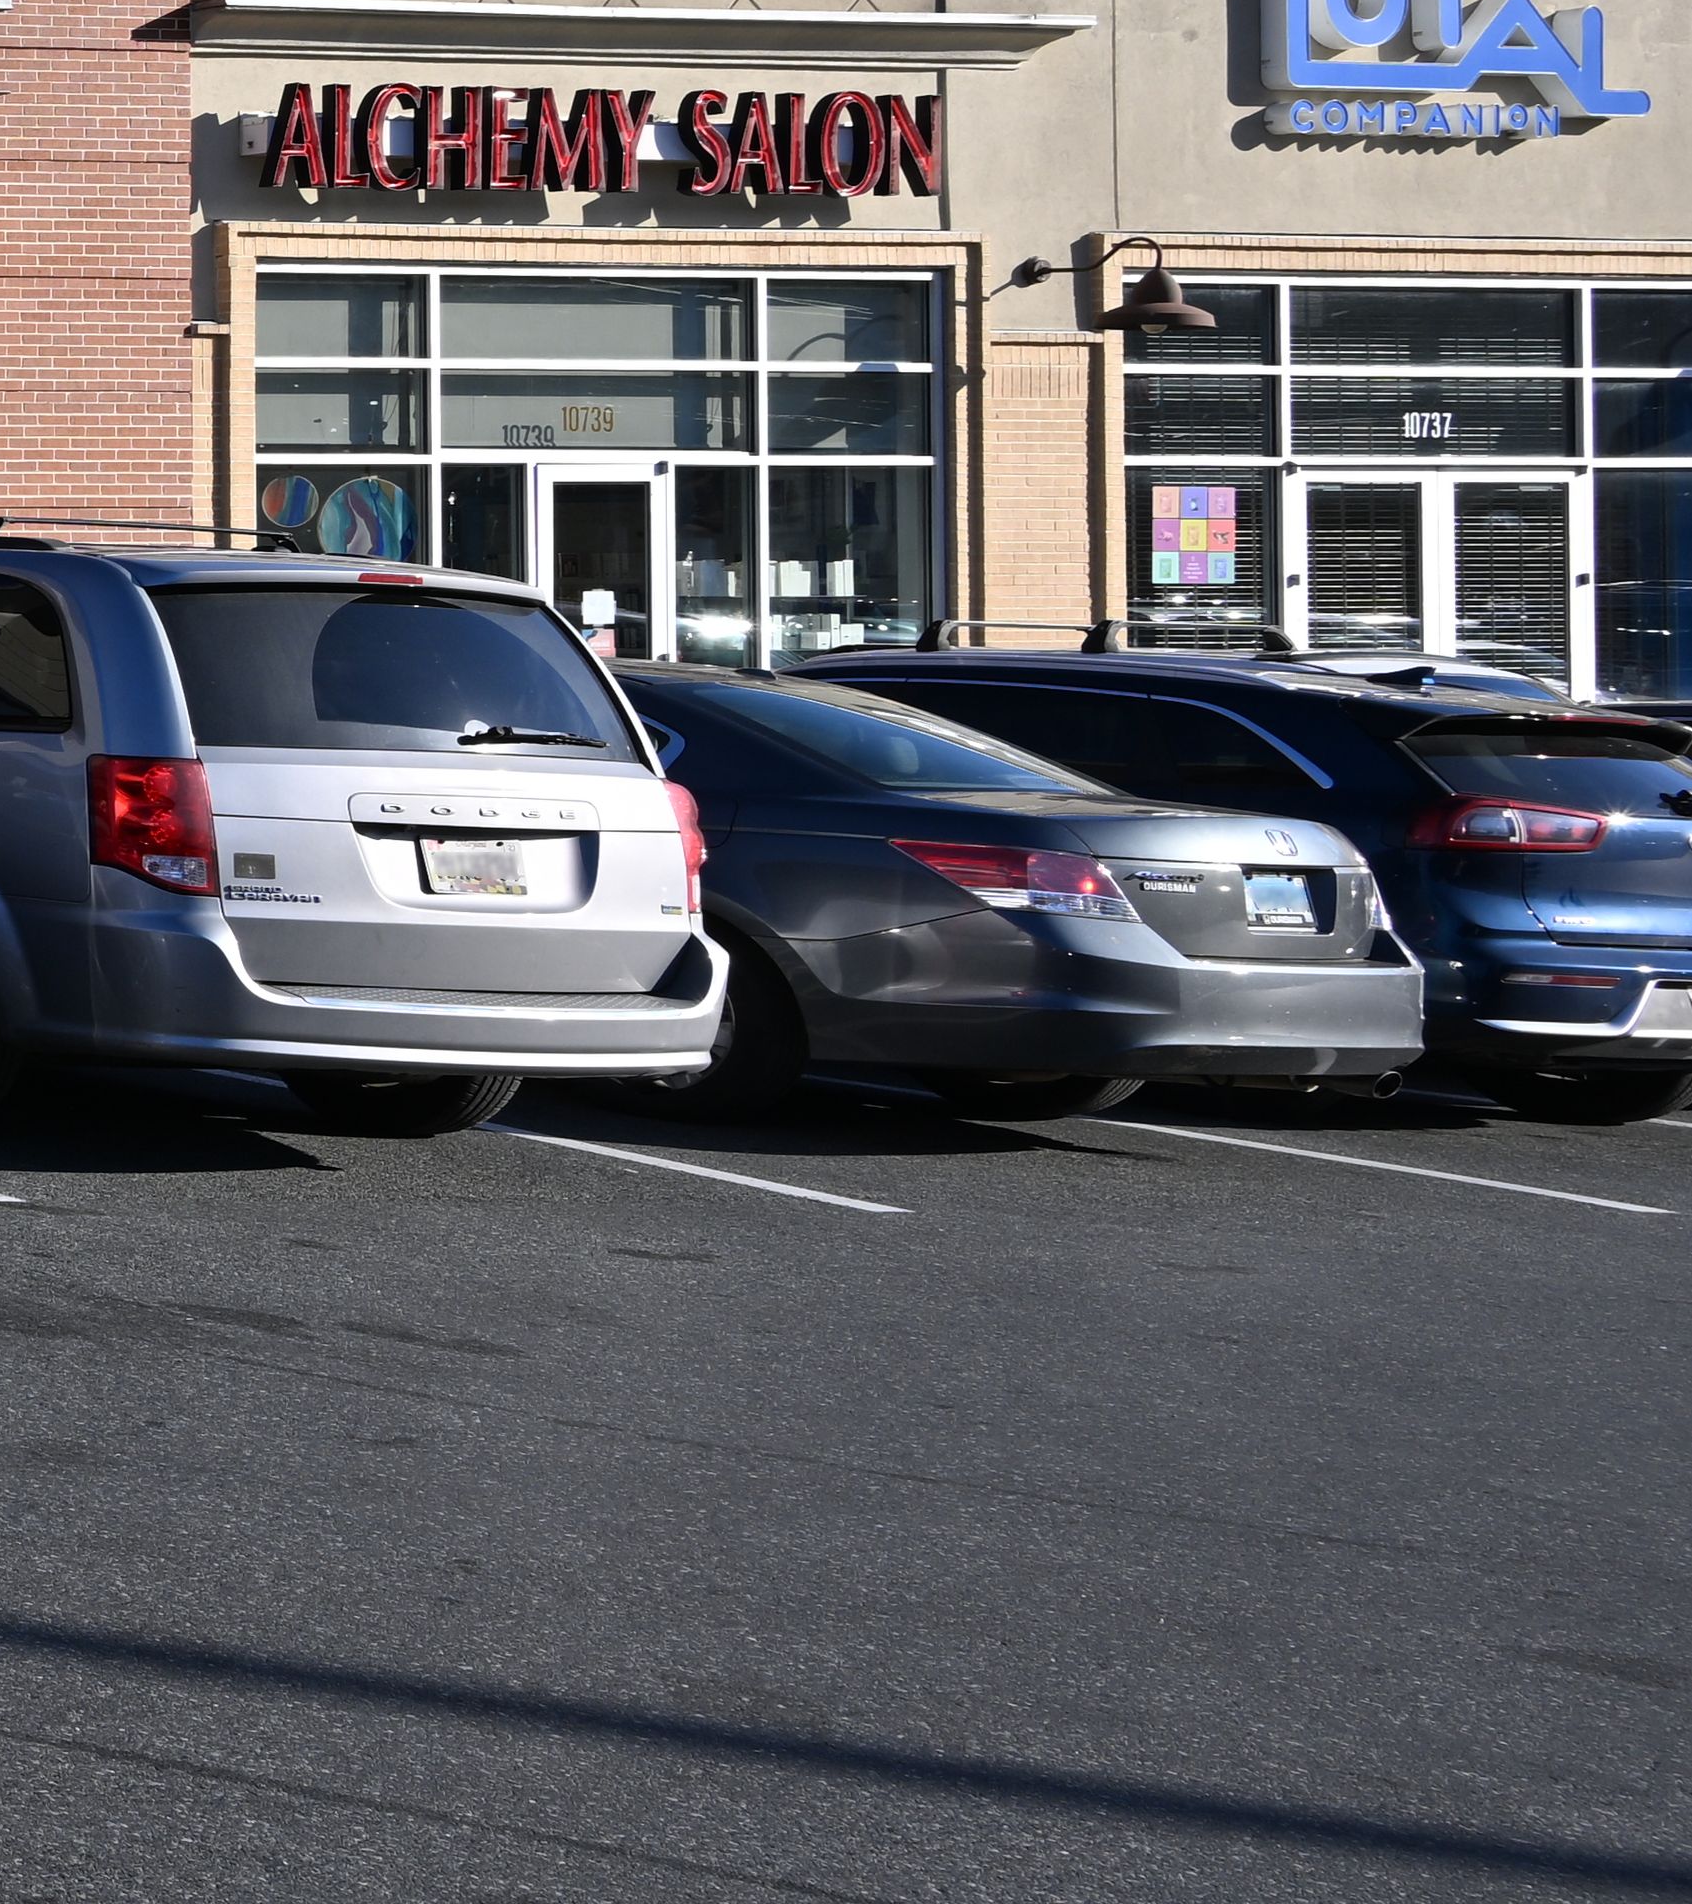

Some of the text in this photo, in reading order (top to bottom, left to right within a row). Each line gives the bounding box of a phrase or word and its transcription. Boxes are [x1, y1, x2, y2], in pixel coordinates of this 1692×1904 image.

[1287, 99, 1563, 138] COMPANION
[261, 82, 942, 197] ALCHEMY SALON
[561, 406, 614, 432] 10739
[1402, 411, 1452, 439] 10737
[380, 802, 576, 820] DODGE
[1142, 882, 1196, 894] OURISMAN
